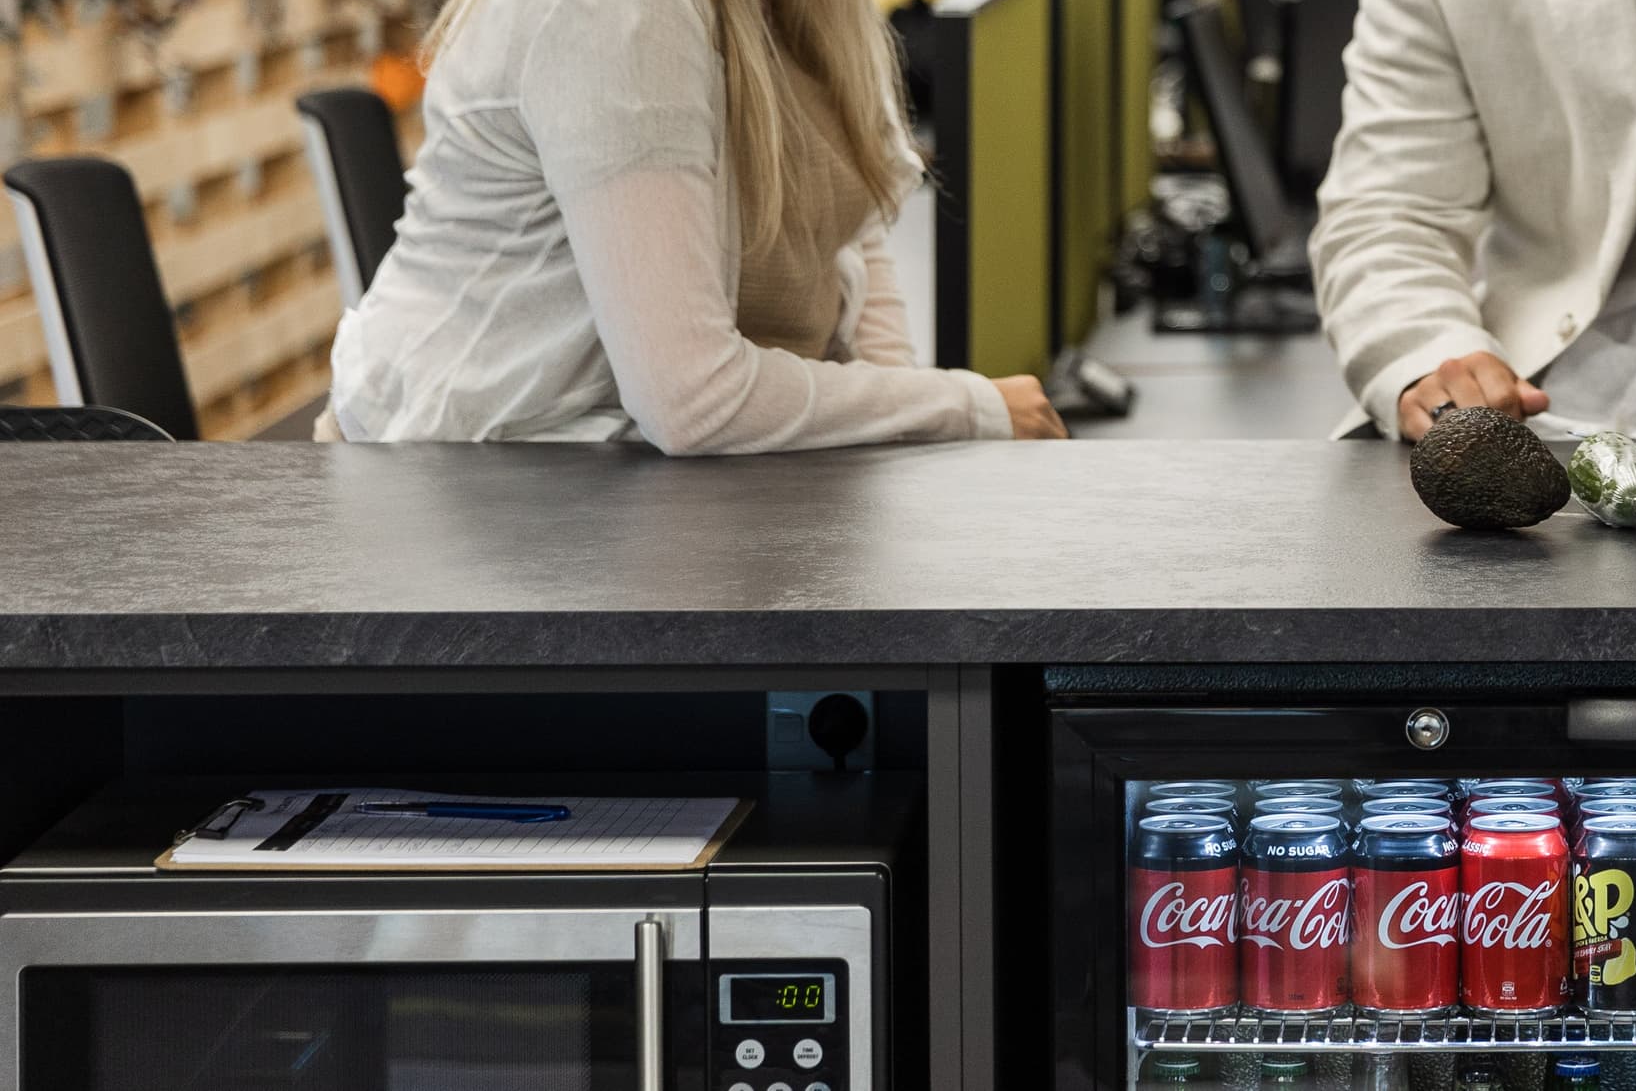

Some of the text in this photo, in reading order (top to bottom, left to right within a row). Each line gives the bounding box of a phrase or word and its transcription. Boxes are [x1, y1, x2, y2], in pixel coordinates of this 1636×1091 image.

[1204, 842, 1221, 855] NO
[1267, 844, 1331, 857] NO SUGAR
[1573, 868, 1635, 941] &P
[776, 984, 821, 1009] :00
